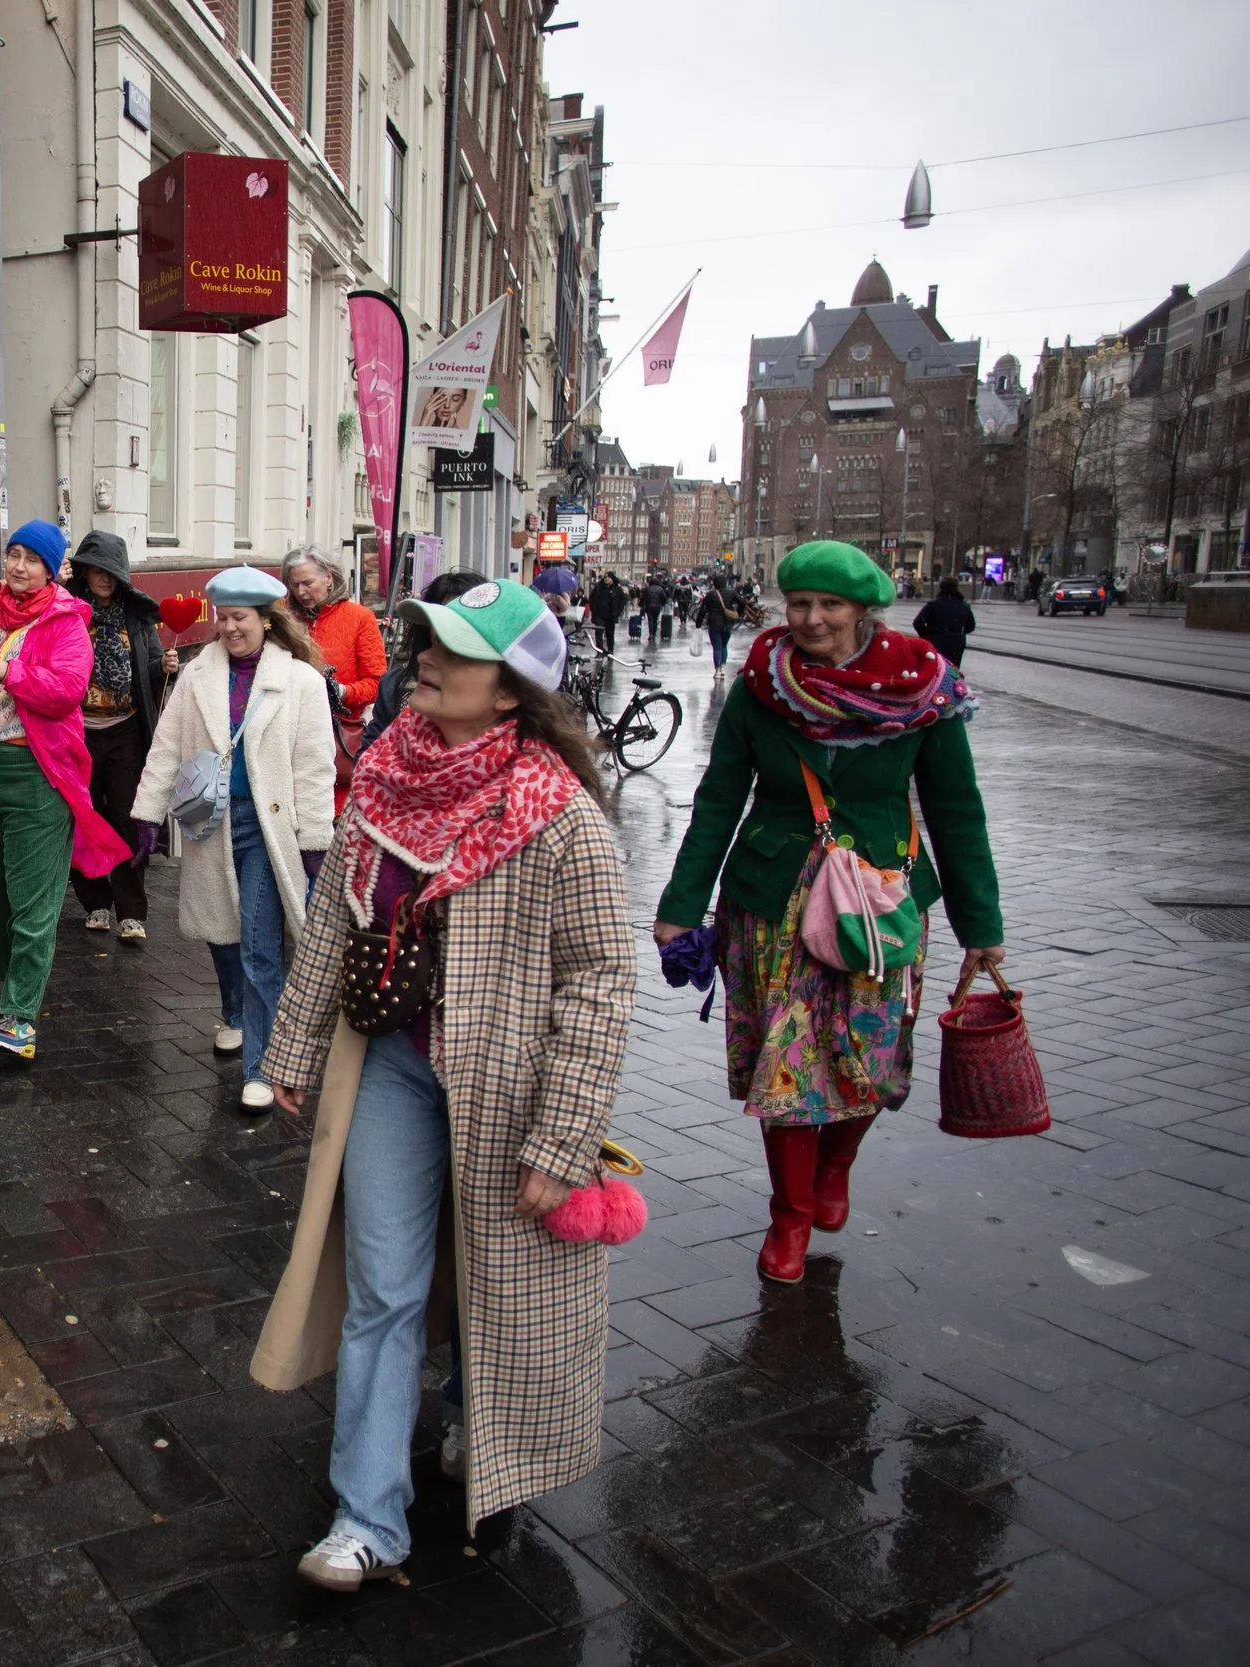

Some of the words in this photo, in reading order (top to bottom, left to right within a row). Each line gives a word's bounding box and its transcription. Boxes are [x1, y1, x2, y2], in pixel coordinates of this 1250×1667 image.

[190, 260, 230, 279] Cave
[235, 263, 282, 282] Rokin
[201, 282, 222, 292] Wine
[222, 284, 229, 292] &
[229, 284, 253, 295] Liquor
[254, 285, 273, 296] Shop
[428, 362, 486, 374] L'Oriental
[650, 359, 675, 371] ORI
[441, 462, 487, 473] PUERTO
[453, 472, 474, 482] INK
[585, 544, 600, 553] UPER
[584, 555, 602, 564] ARKET
